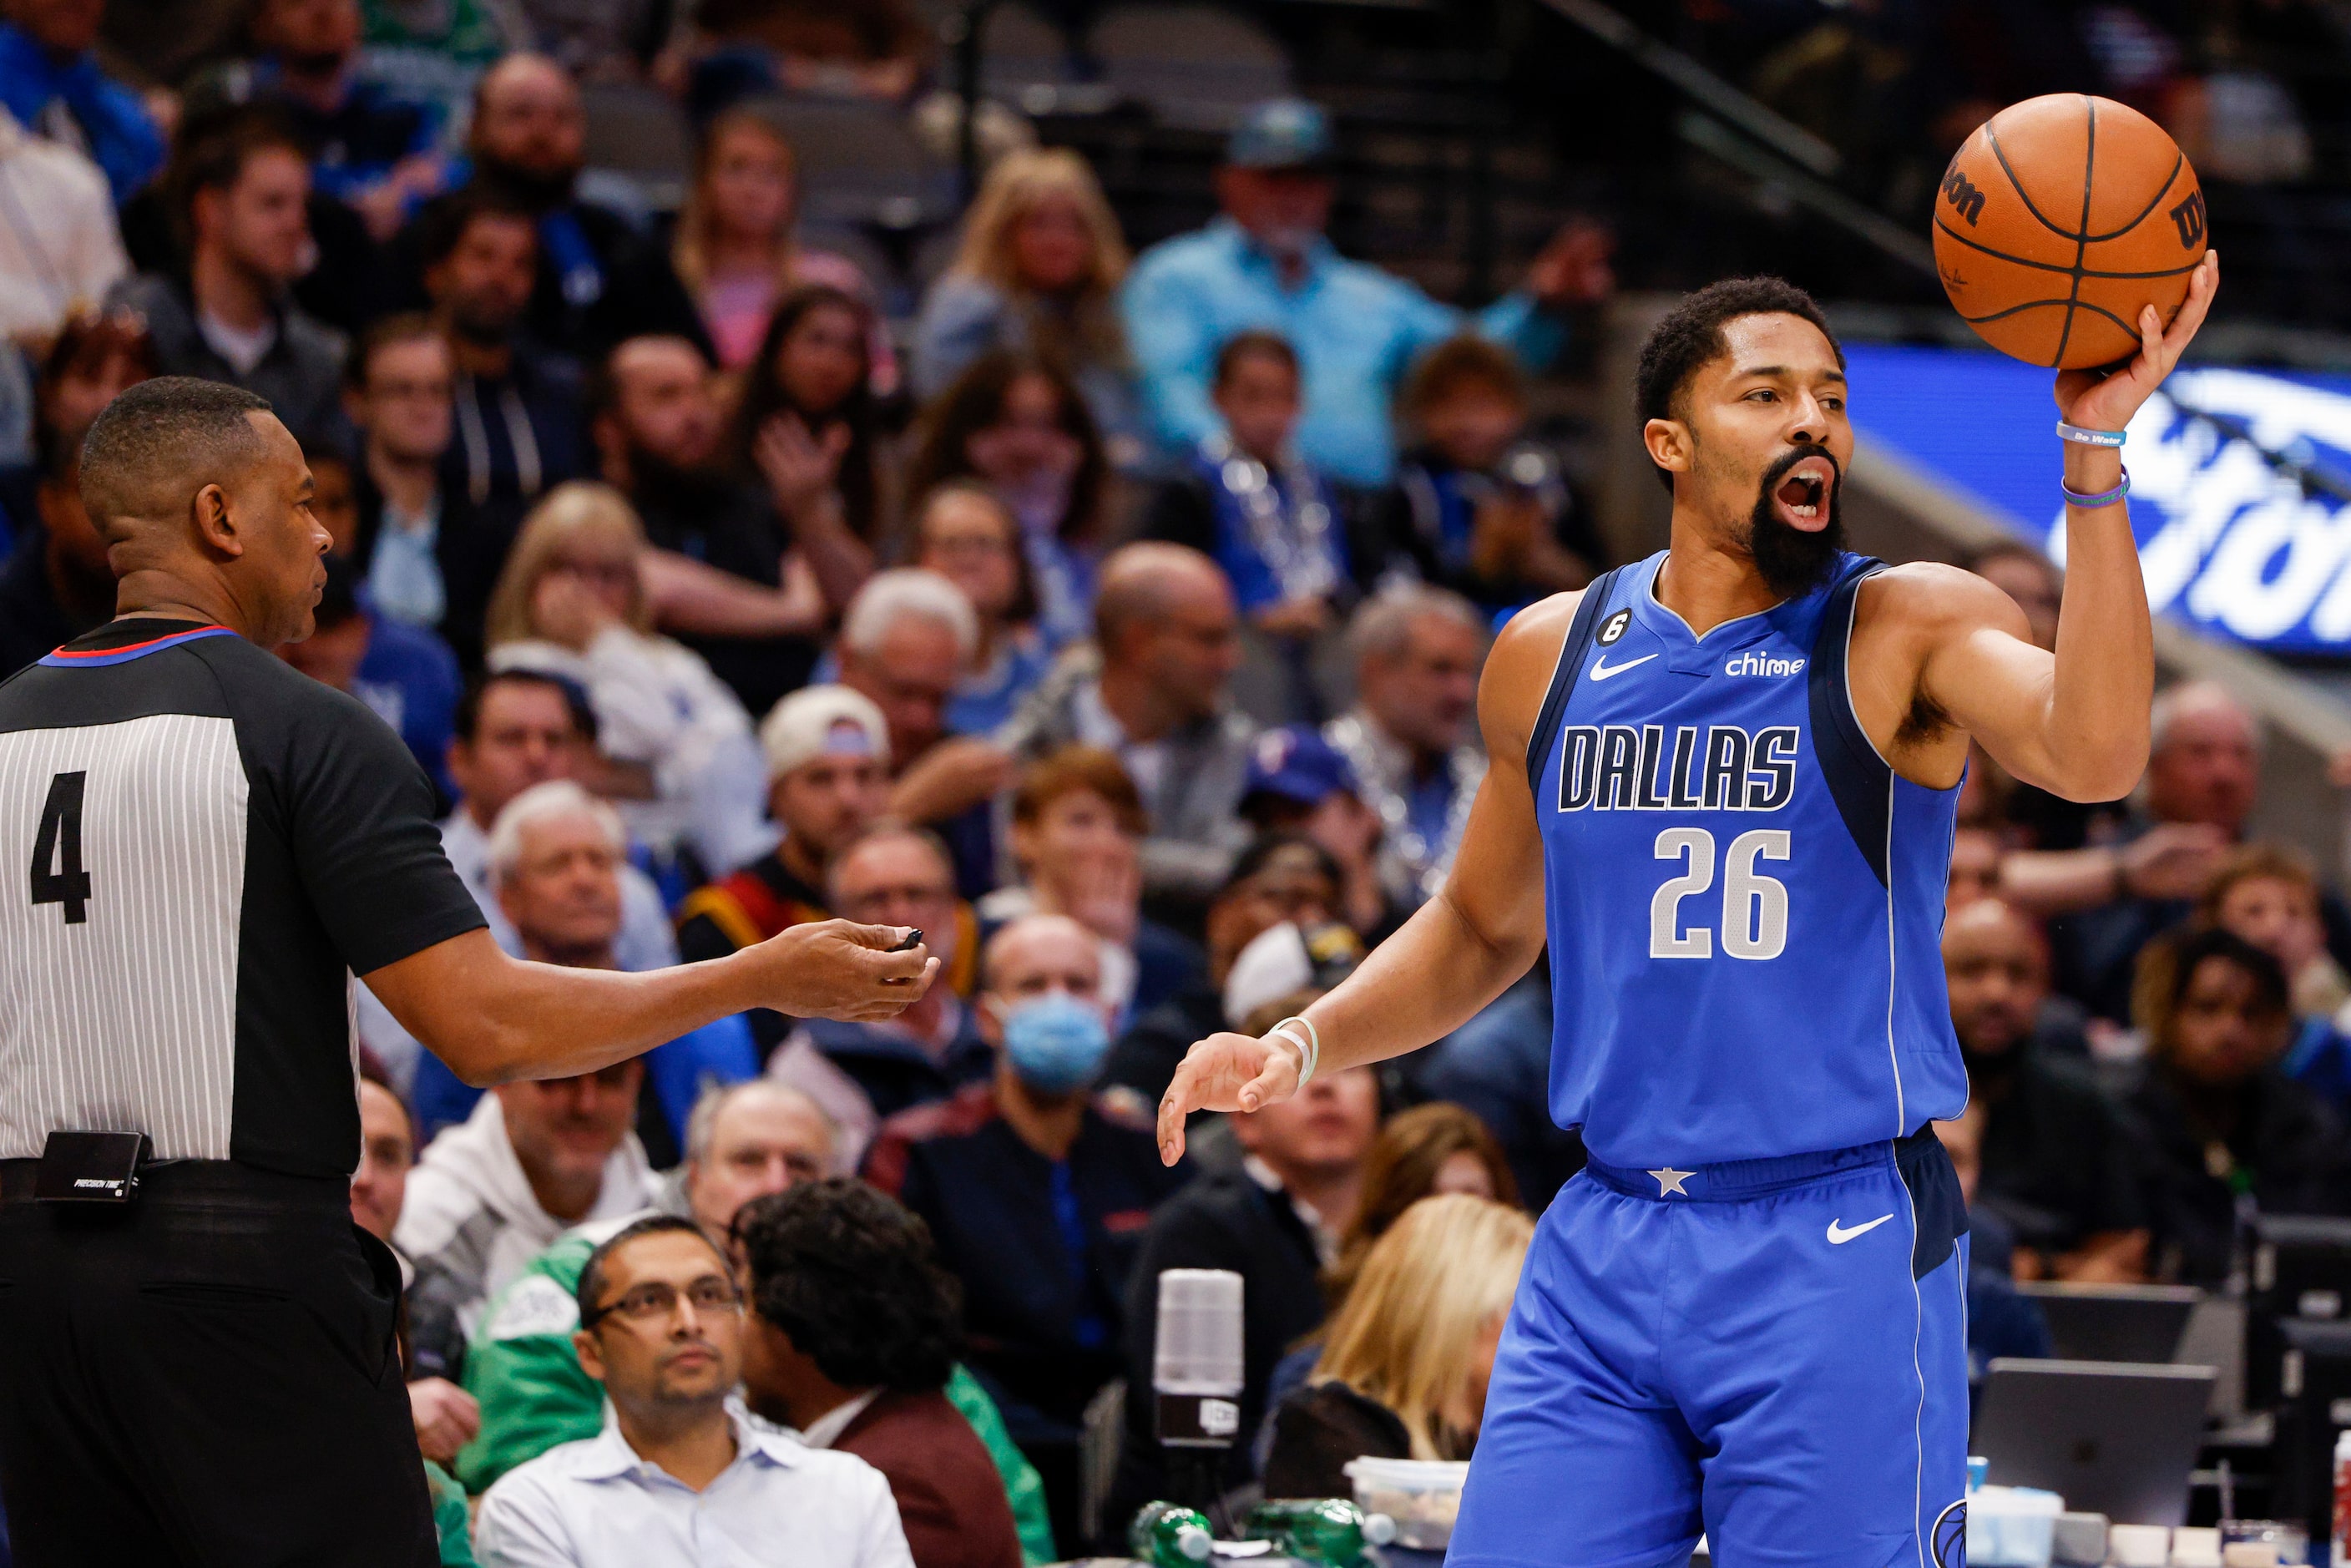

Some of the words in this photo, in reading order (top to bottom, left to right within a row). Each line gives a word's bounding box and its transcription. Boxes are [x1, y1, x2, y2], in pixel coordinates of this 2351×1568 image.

[2074, 432, 2090, 442] Be
[2091, 434, 2121, 445] Water
[1602, 612, 1628, 642] 6
[1725, 650, 1806, 677] chime
[1558, 724, 1800, 813] DALLAS
[30, 770, 92, 924] 4
[1649, 827, 1791, 960] 26
